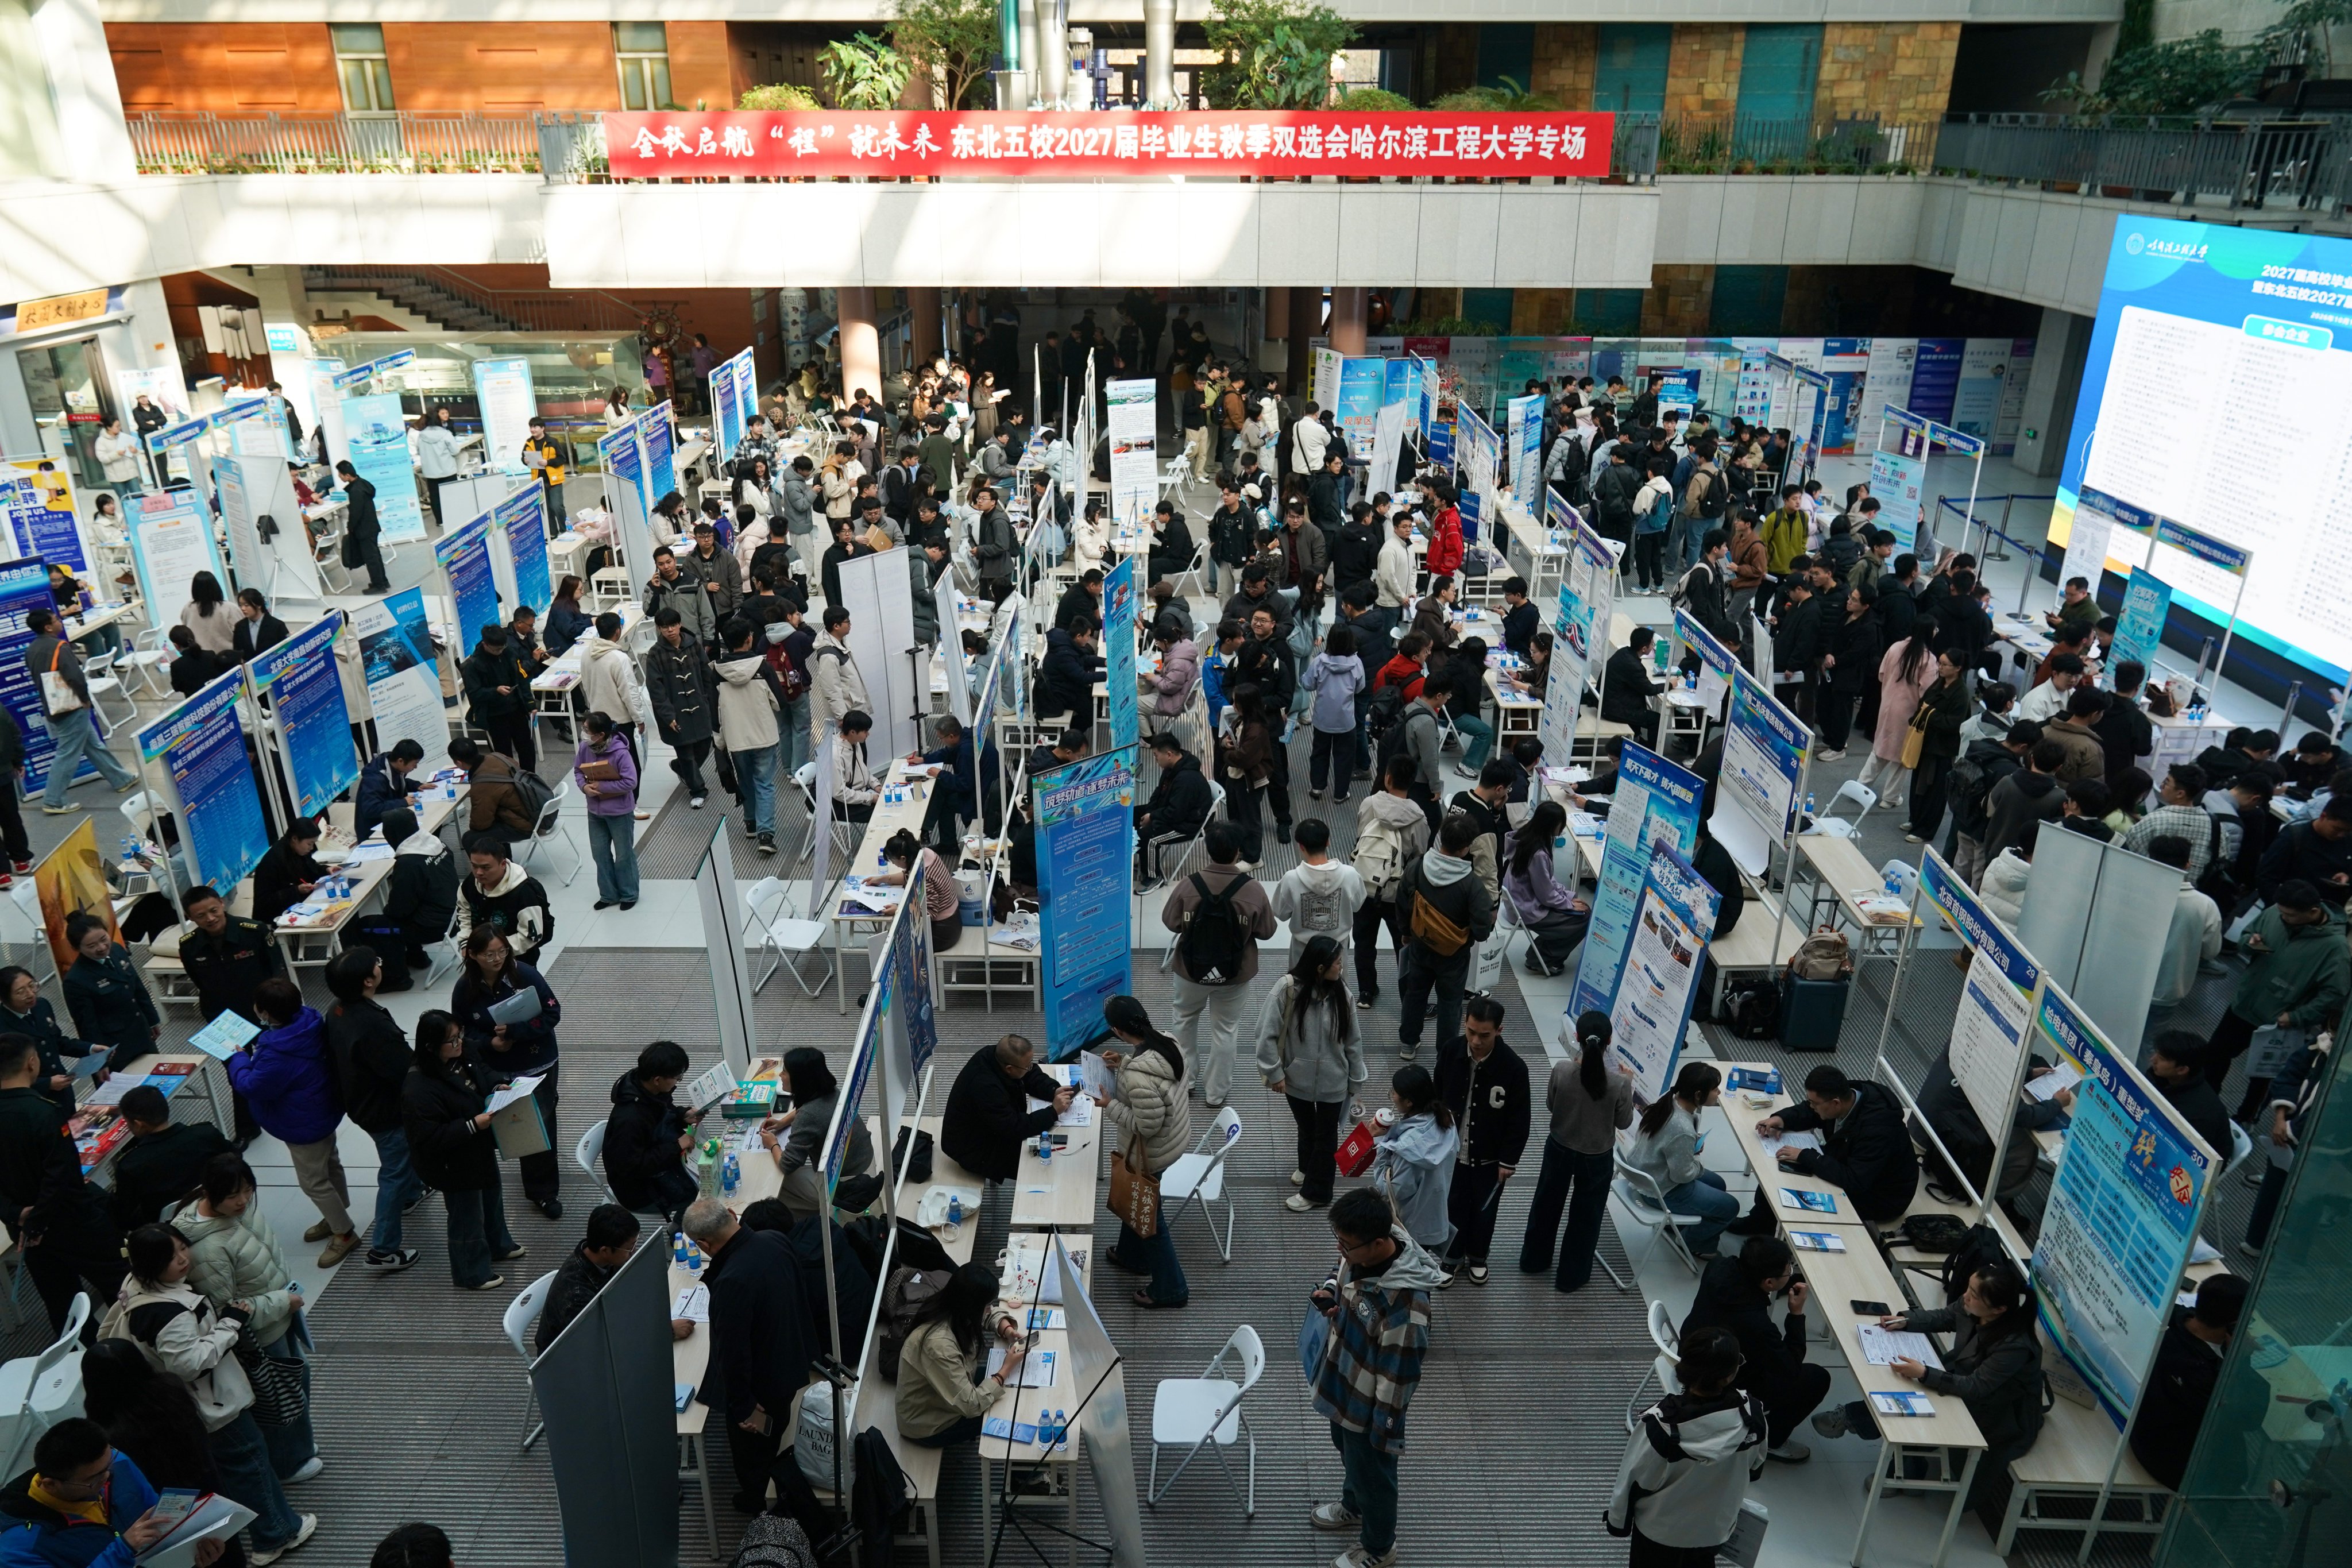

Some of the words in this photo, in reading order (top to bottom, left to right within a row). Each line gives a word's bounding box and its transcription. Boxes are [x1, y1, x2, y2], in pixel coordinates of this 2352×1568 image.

[630, 125, 755, 159] 金秋启航
[950, 123, 1586, 160] 东北五校2027届毕业生秋季双选会哈尔滨工程大学专场
[2262, 322, 2309, 343] 参会企业
[1344, 416, 1373, 426] 观摩区
[1872, 474, 1901, 488] 共创未来
[1874, 464, 1887, 476] 向上
[1891, 469, 1907, 481] 向新
[33, 508, 46, 516] US
[396, 601, 419, 615] 招聘信息
[270, 628, 333, 674] 北京大学南昌创新研究院
[149, 683, 241, 752] 南昌三瑞智能科技股份有限公司
[1742, 687, 1794, 745] 济南二机床集团有限公司
[1799, 732, 1806, 742] 28
[1790, 757, 1797, 768] 28
[1044, 784, 1086, 811] 筑梦轨道
[1086, 770, 1130, 797] 逐梦未来
[1625, 758, 1659, 784] 聚天下英才
[1660, 776, 1694, 804] 铸大国重器
[1938, 885, 2010, 974] 北京首钢股份有限公司
[2025, 965, 2036, 979] 29
[1489, 1085, 1506, 1109] C
[2190, 1150, 2204, 1168] 30
[798, 1426, 833, 1444] LAUND
[811, 1441, 832, 1455] BAG
